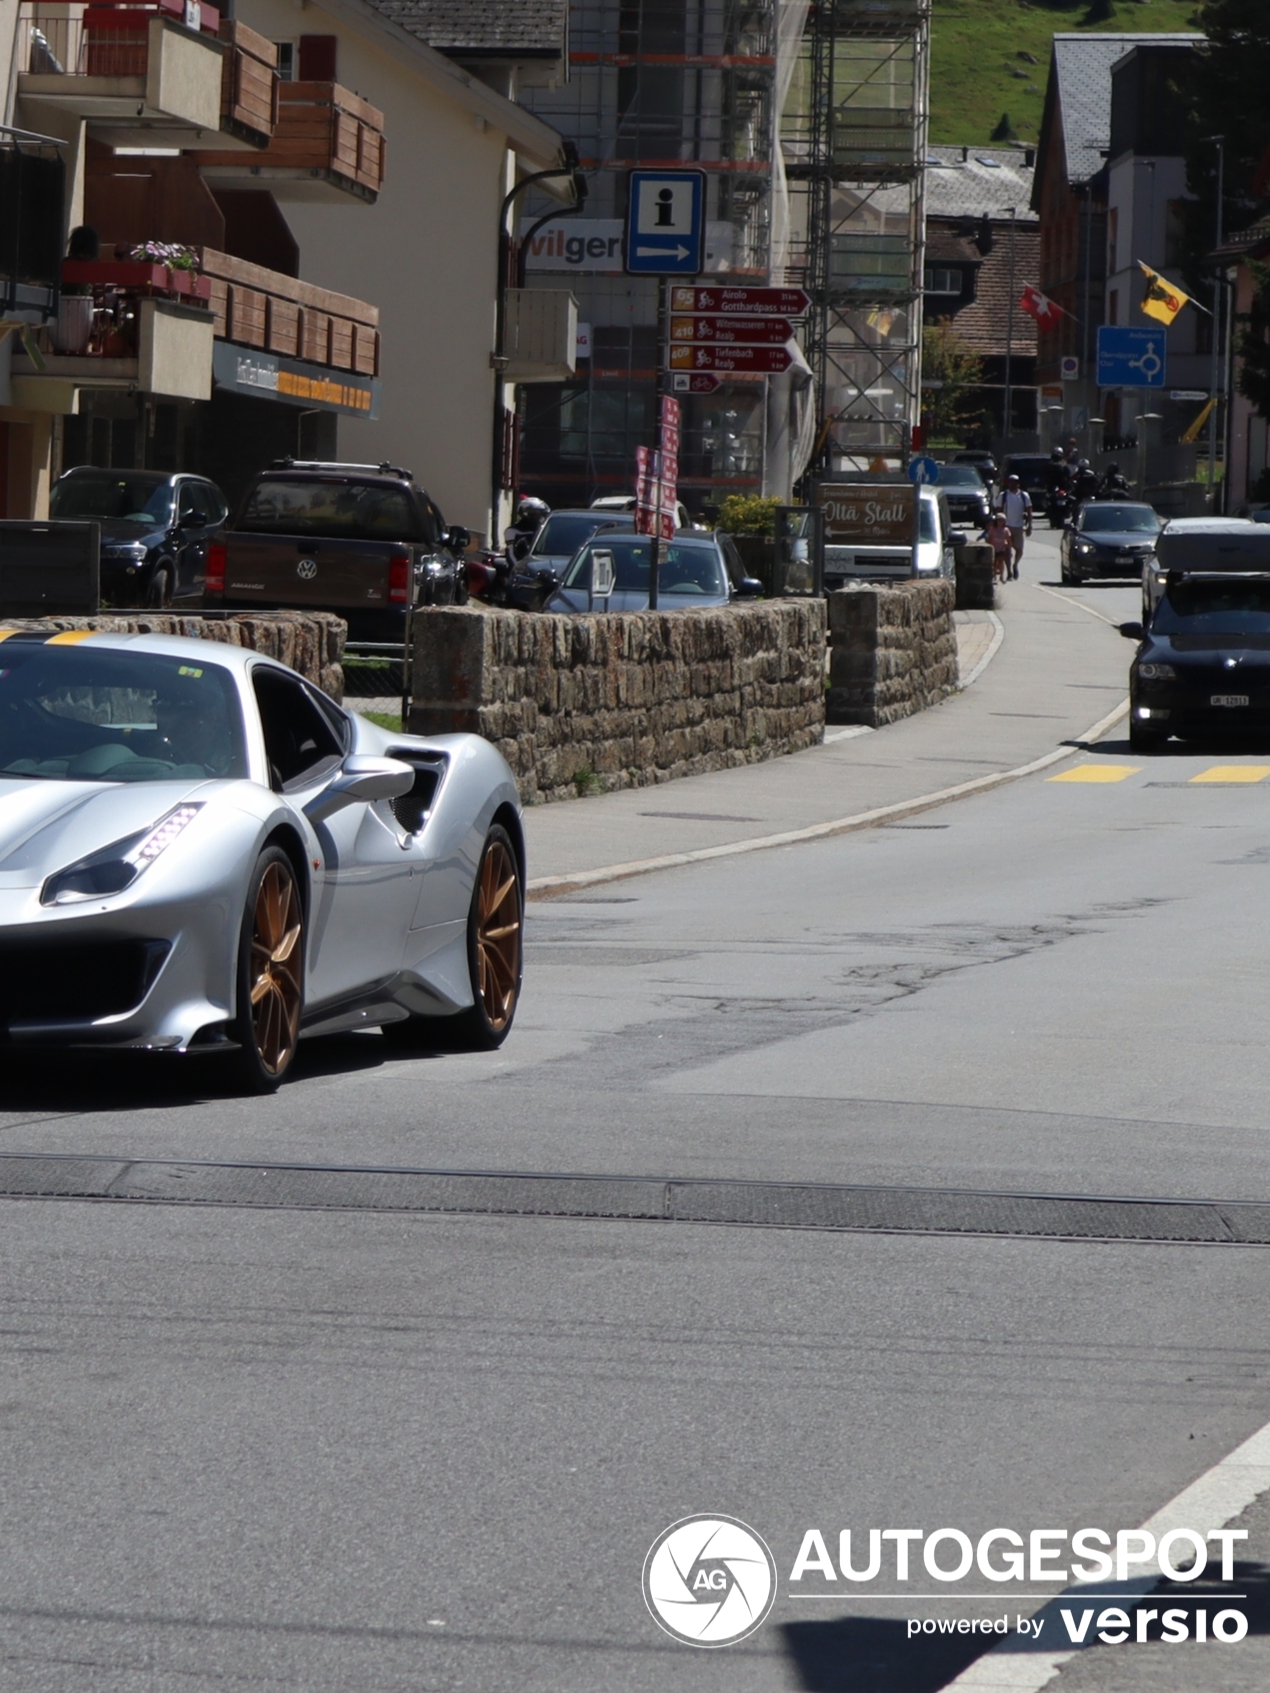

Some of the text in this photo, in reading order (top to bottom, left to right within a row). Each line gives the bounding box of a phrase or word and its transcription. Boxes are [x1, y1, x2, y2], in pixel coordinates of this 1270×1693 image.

[677, 289, 695, 304] 65
[722, 290, 747, 300] Airolo
[721, 302, 777, 313] Gotthardpass
[675, 327, 694, 337] 410
[715, 331, 735, 341] Realp
[671, 347, 690, 359] 409
[715, 348, 754, 358] Tiefenbach
[715, 359, 735, 370] Realp
[822, 501, 907, 525] Oltä Stall
